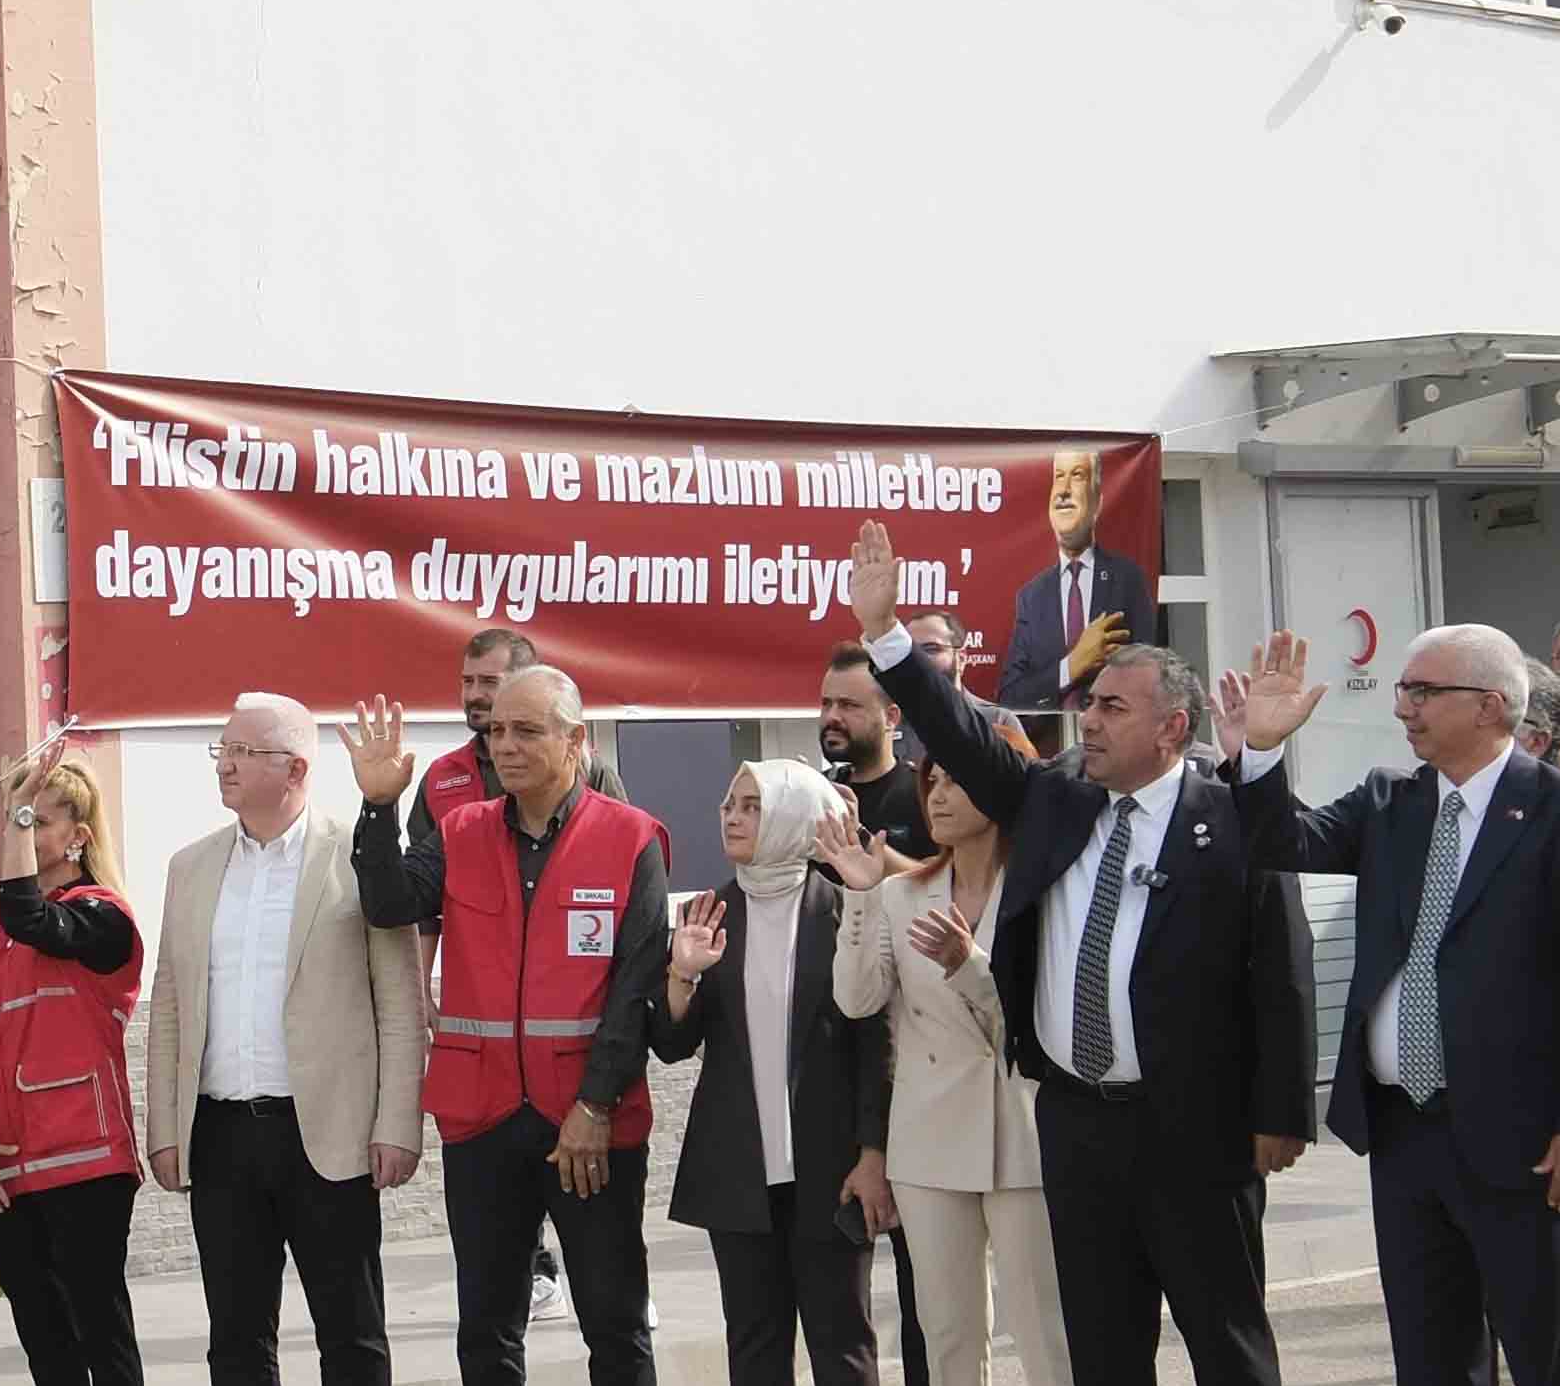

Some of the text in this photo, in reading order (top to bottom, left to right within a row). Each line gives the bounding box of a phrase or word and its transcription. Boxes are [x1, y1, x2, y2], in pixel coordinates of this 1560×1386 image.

[315, 429, 508, 500] halkına
[531, 453, 582, 502] ve
[596, 445, 784, 507] mazlum
[796, 451, 1004, 513] milletlere
[94, 529, 398, 618] dayanışma
[410, 538, 710, 622] duygularımı
